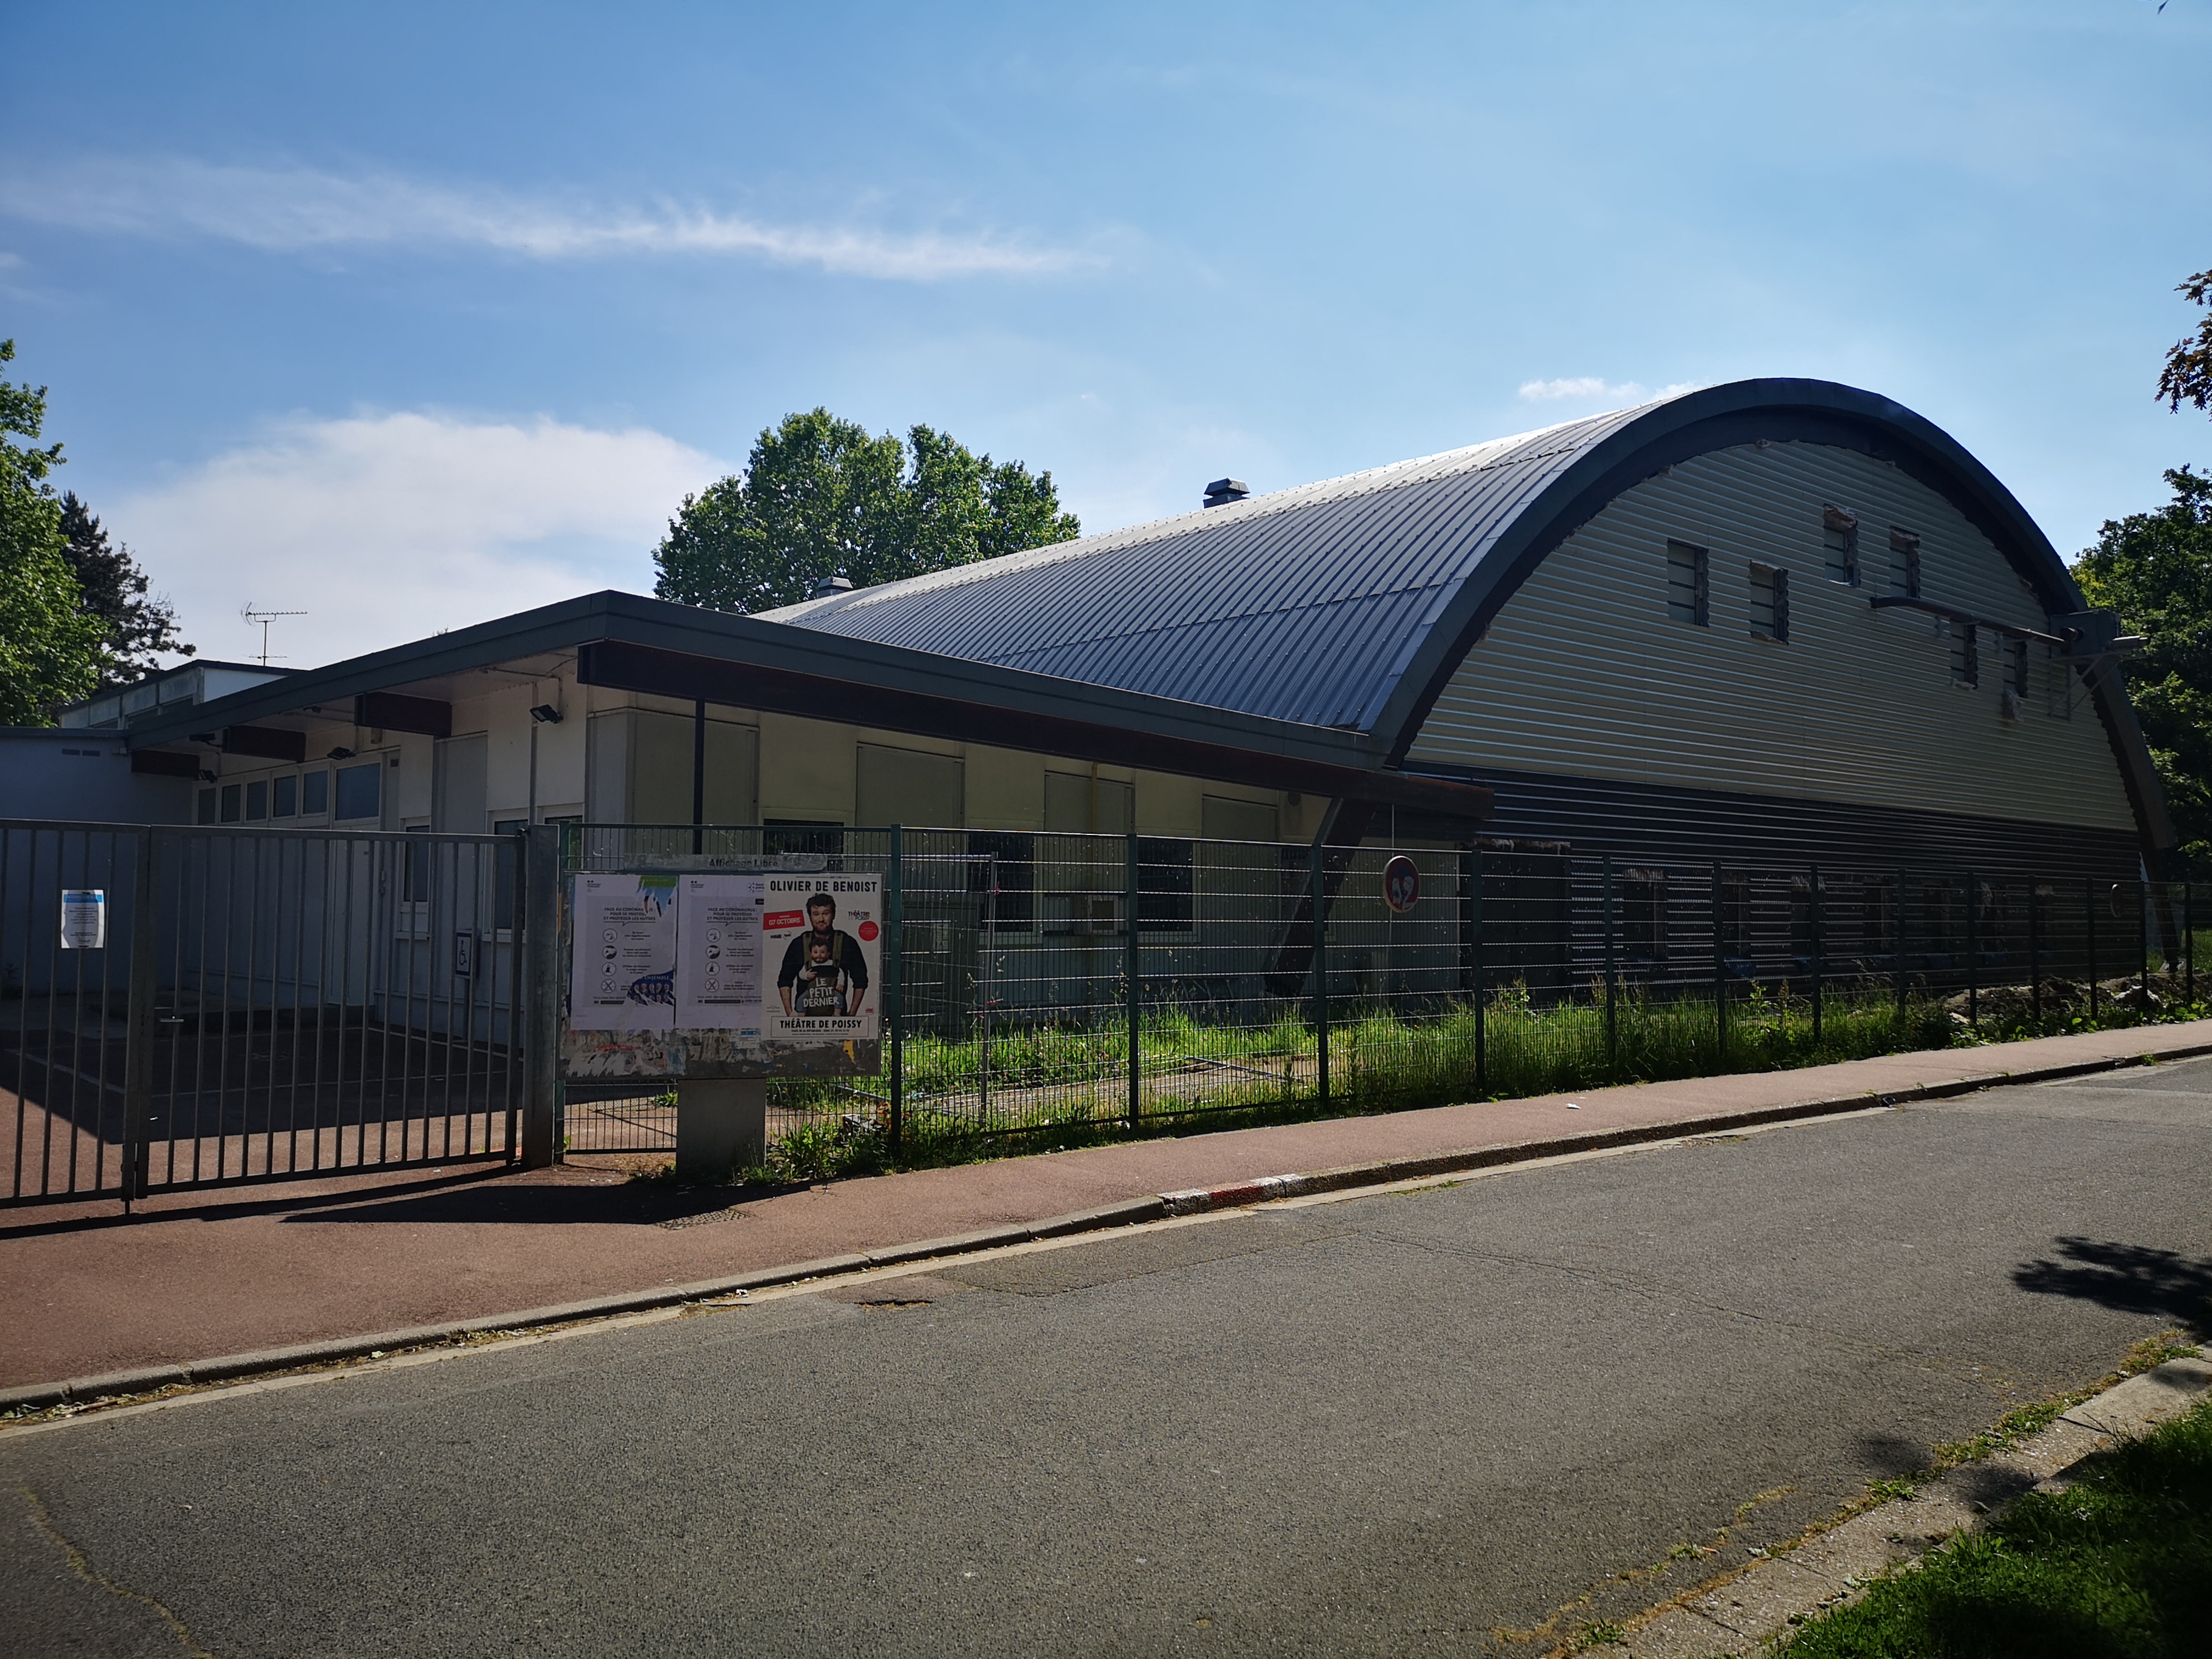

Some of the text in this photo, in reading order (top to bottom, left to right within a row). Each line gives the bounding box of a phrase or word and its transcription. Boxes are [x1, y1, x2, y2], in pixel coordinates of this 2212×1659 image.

[770, 880, 811, 891] OLIVIER
[816, 881, 828, 891] DE
[833, 881, 877, 892] BENOIST
[816, 978, 826, 987] LE
[809, 987, 833, 998] PETIT
[803, 997, 840, 1007] DERNIER
[780, 1018, 816, 1028] THÉÂTRE
[832, 1020, 862, 1028] POISSY
